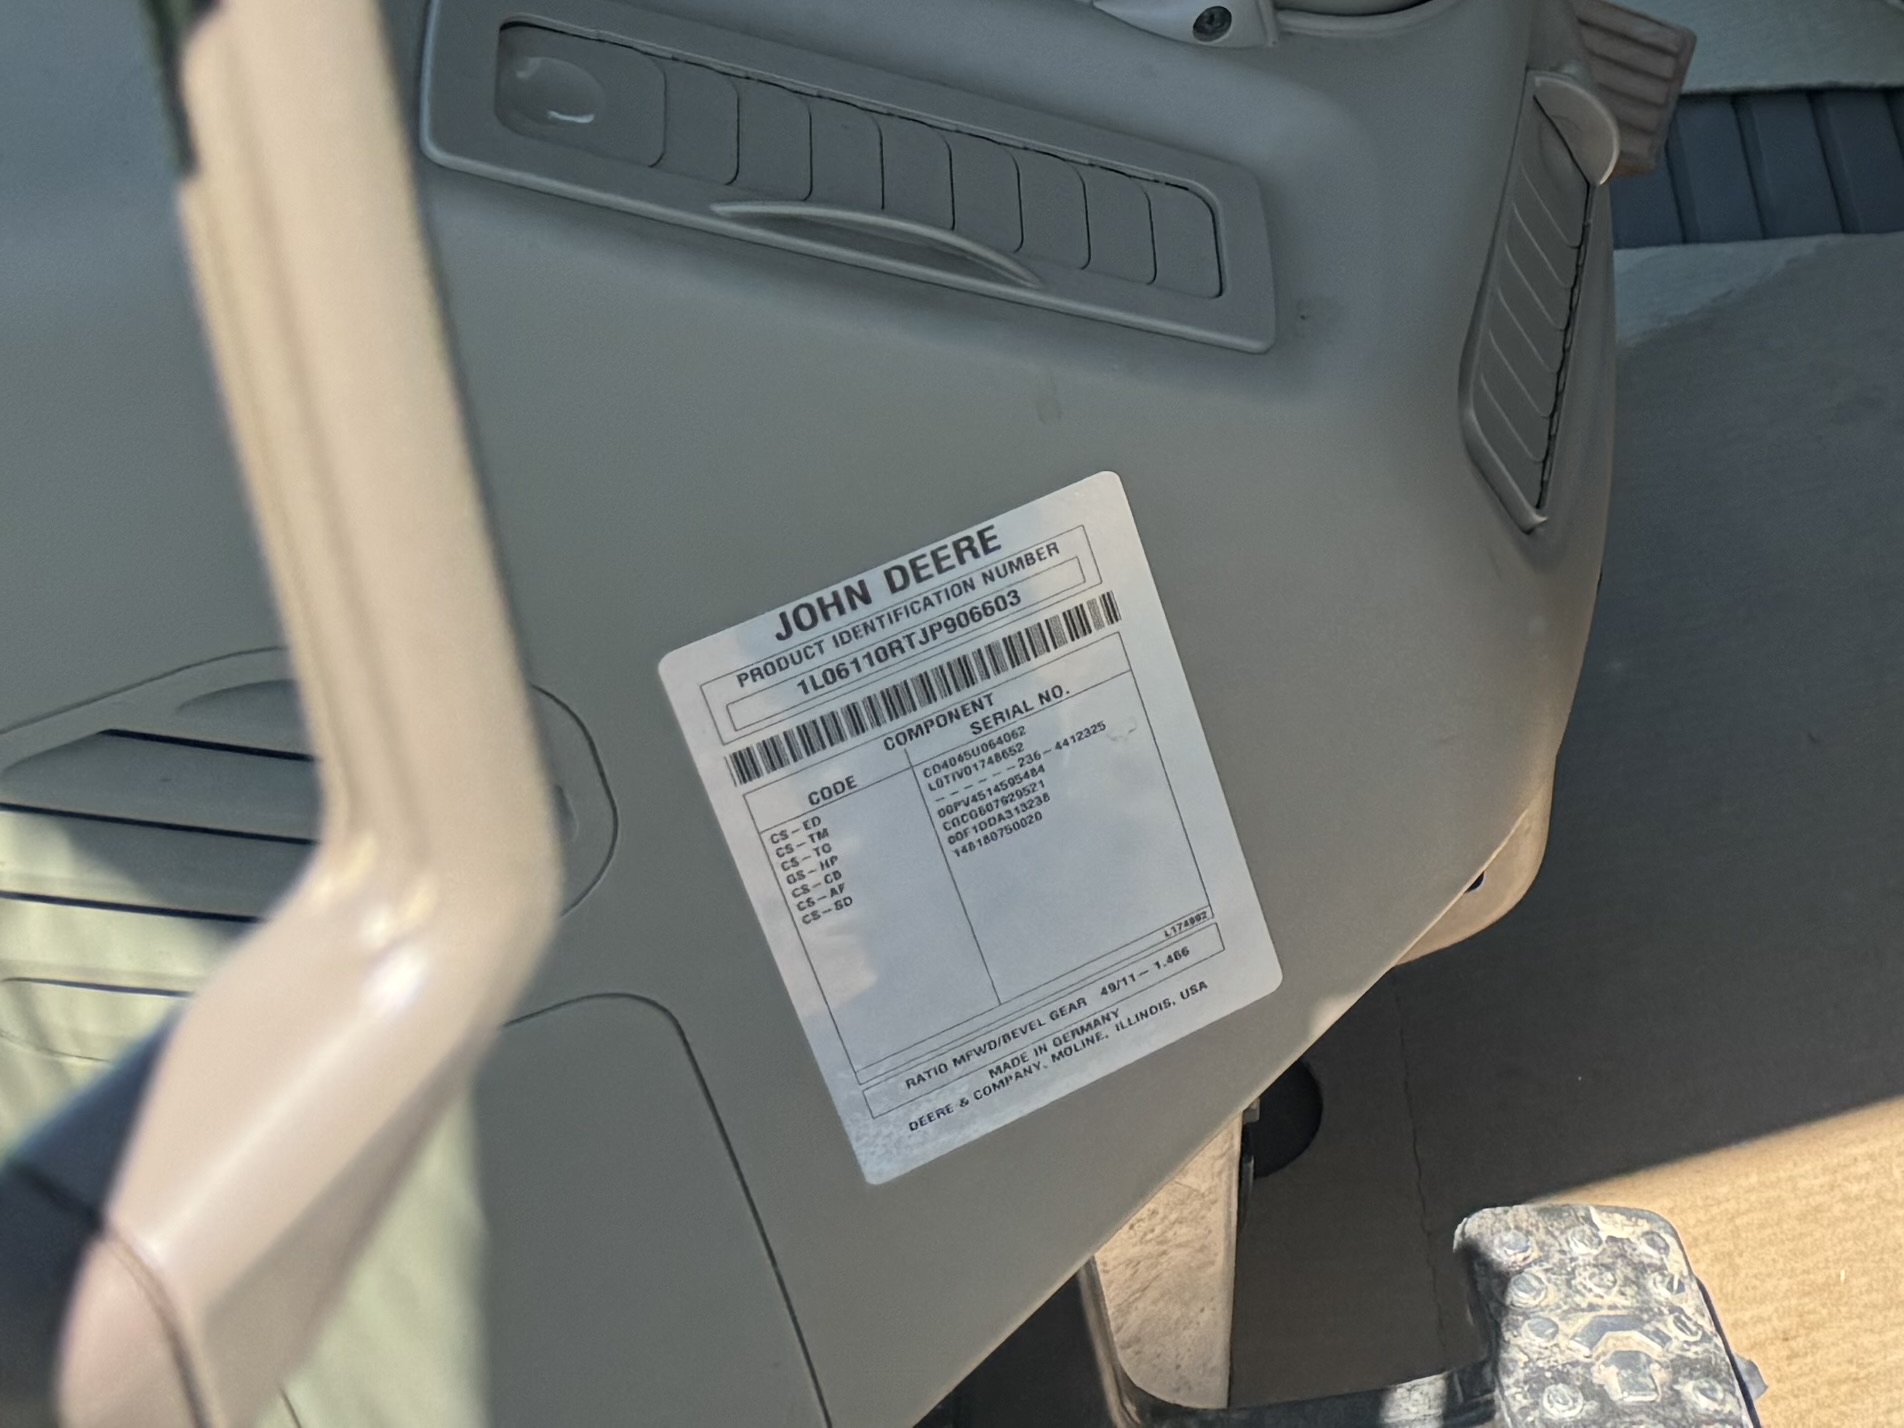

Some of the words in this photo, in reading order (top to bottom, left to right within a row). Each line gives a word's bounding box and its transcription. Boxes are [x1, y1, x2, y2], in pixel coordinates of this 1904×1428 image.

[735, 638, 825, 689] PRODUCT
[831, 576, 977, 649] IDENTIFICATION
[980, 541, 1061, 586] NUMBER
[774, 578, 873, 642] JOHN
[882, 524, 1003, 596] DEERE
[796, 588, 1022, 696] 1L06110RTJP906603
[882, 691, 994, 752] COMPONENT
[969, 699, 1035, 736] SERIAL
[1037, 684, 1071, 706] NO.
[807, 774, 858, 807] CODE
[904, 1062, 949, 1090] RATIO
[951, 1018, 1047, 1068] MFWD/BEVEL
[1048, 997, 1088, 1022] GEAR
[907, 1103, 955, 1132] DEERE
[958, 1096, 970, 1108] &
[1179, 980, 1209, 1001] USA
[987, 1051, 1030, 1080] MADE
[1032, 1042, 1049, 1058] IN
[1051, 1007, 1120, 1048] GERMANY
